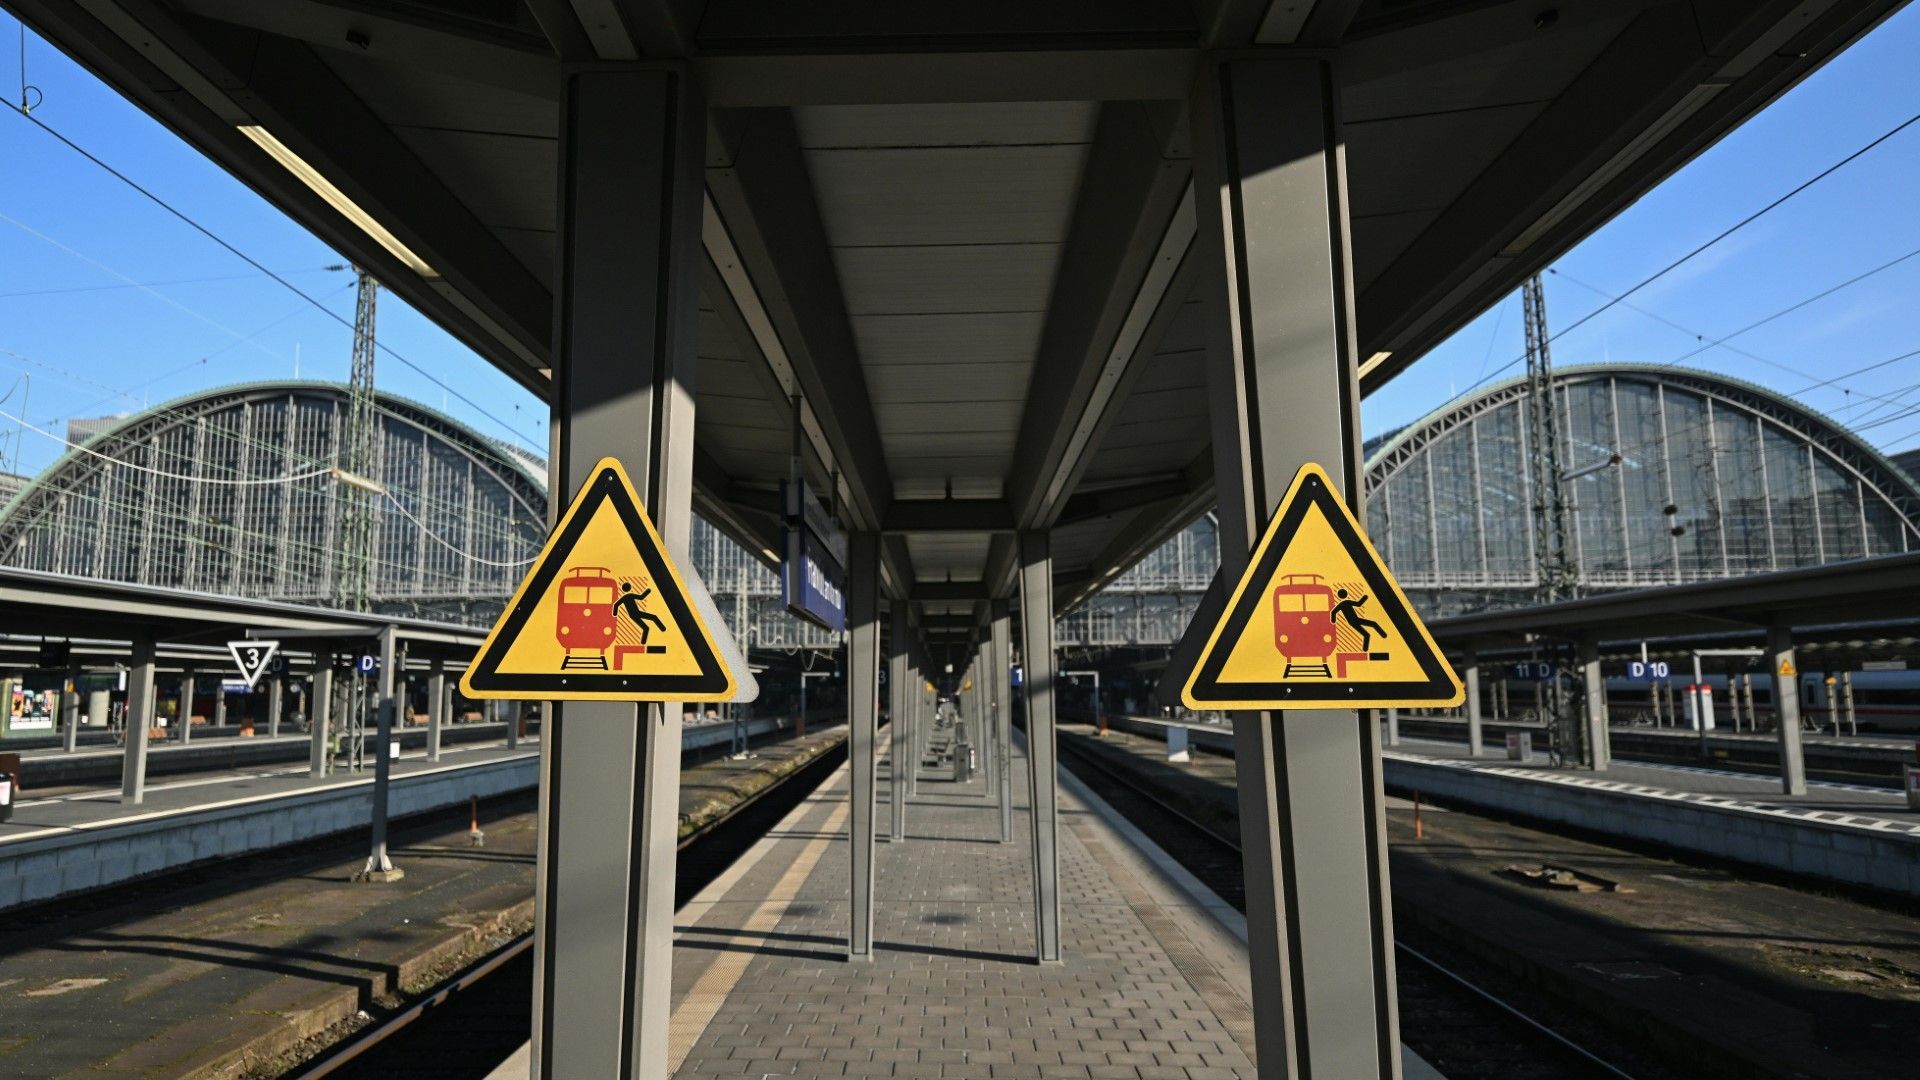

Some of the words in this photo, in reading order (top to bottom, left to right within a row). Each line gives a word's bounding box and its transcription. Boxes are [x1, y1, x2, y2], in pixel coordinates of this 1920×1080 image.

[245, 648, 260, 670] 3
[362, 655, 374, 671] D
[1516, 664, 1530, 678] 11
[1539, 663, 1550, 678] D
[1632, 661, 1645, 678] D
[1650, 661, 1668, 678] 10
